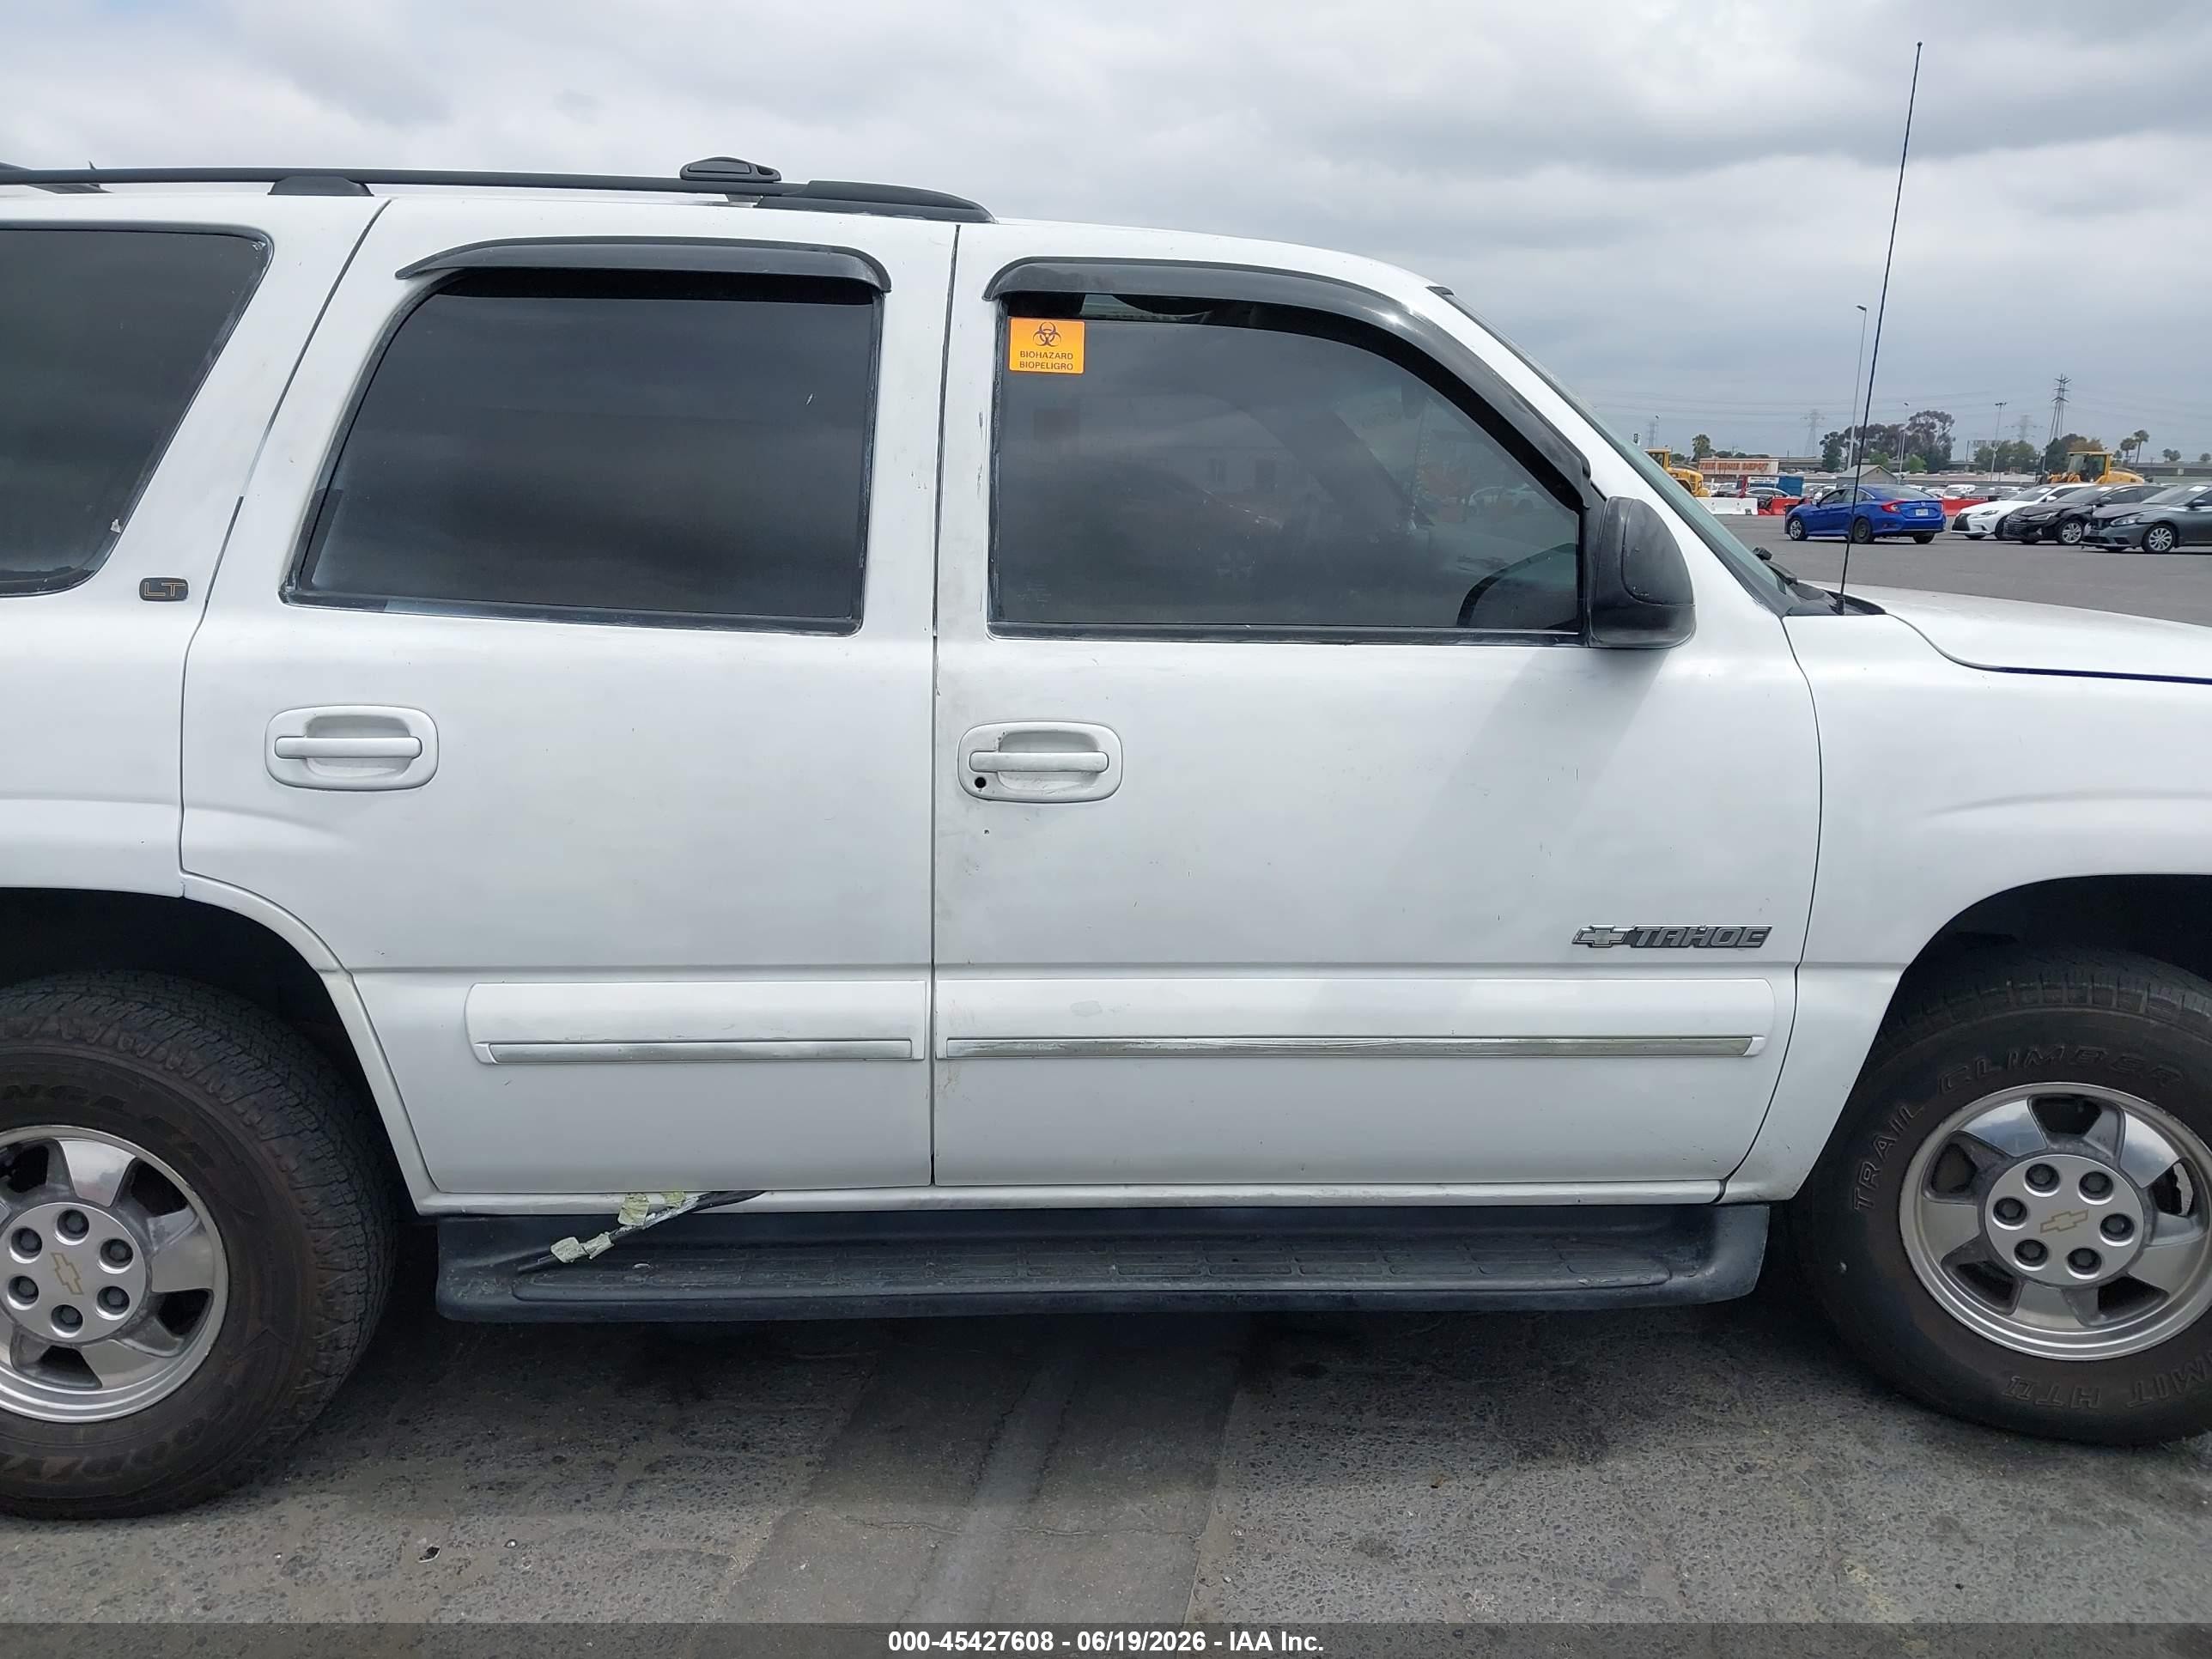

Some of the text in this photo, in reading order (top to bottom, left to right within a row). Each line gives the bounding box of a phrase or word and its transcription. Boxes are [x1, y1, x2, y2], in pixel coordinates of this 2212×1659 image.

[1019, 350, 1073, 360] BIOHAZARD
[1019, 361, 1073, 370] BIOPELIGRO
[143, 581, 186, 597] LT
[1634, 926, 1771, 947] TAHOE
[1851, 1042, 2186, 1212] TRAIL CLIMBER
